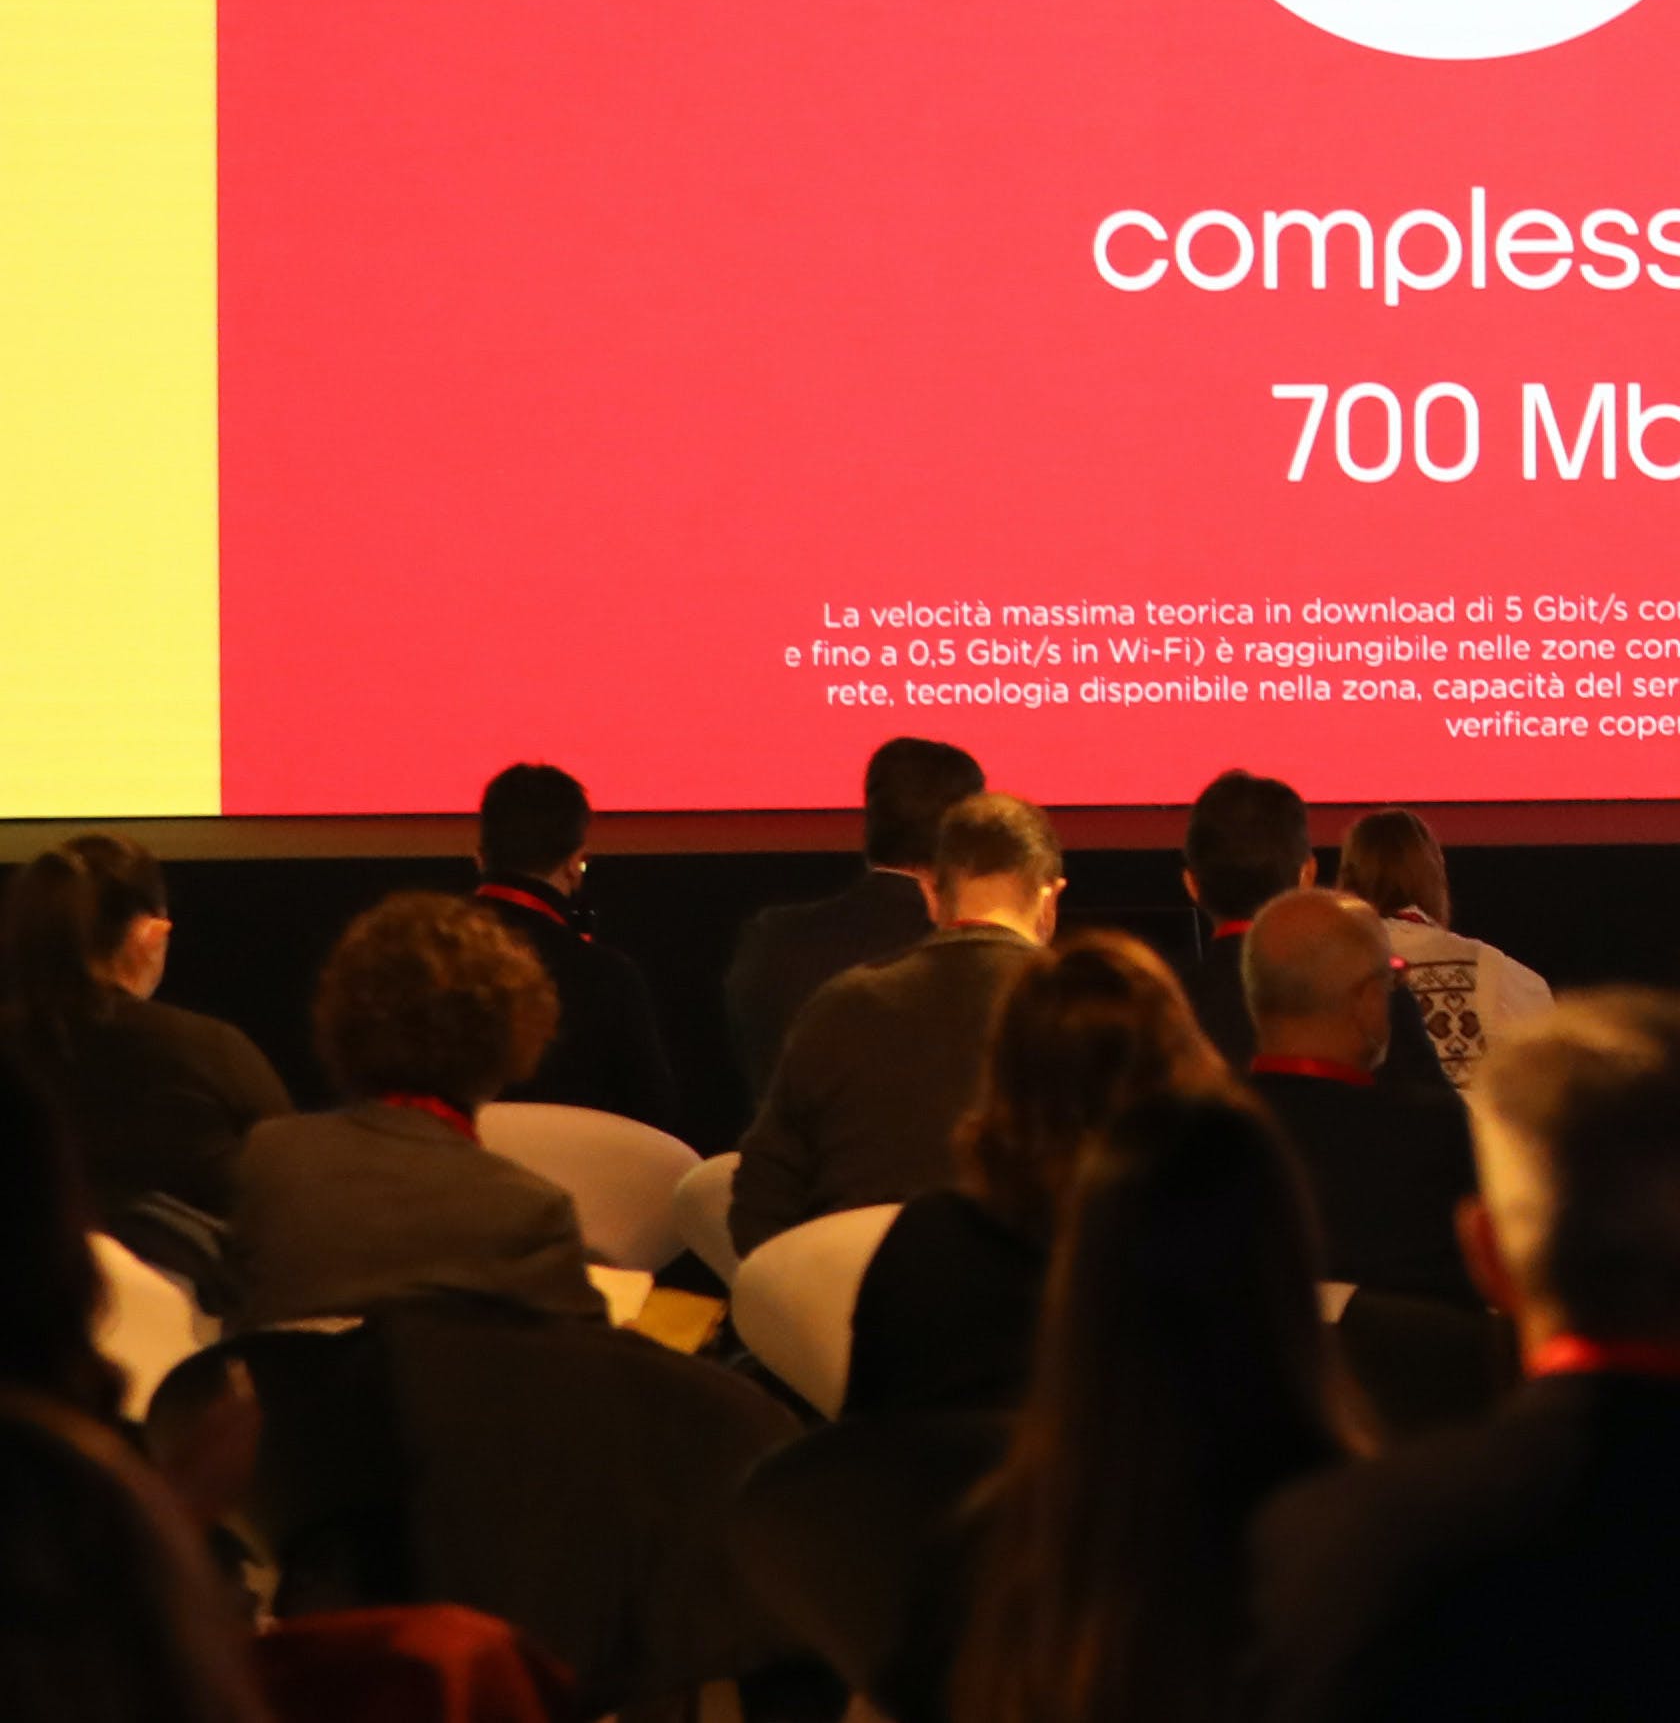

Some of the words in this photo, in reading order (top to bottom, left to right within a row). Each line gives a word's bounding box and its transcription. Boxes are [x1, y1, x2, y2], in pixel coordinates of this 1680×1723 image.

[1271, 381, 1480, 483] 700
[823, 602, 860, 629] La
[869, 600, 992, 628] velocità
[1002, 599, 1135, 627] massima
[1145, 597, 1254, 626] teorica
[1265, 597, 1292, 624] in
[1301, 596, 1455, 625] download
[1465, 595, 1494, 623] di
[1505, 595, 1523, 623] 5
[1533, 592, 1629, 625] Gbit/s
[784, 645, 802, 668] e
[811, 639, 871, 667] fino
[879, 645, 898, 667] a
[907, 638, 956, 668] 0,5
[966, 635, 1062, 668] Gbit/s
[1072, 637, 1099, 664] in
[1107, 636, 1206, 667] Wi-Fi)
[1215, 636, 1234, 664] è
[1244, 634, 1449, 668] raggiungibile
[1458, 634, 1531, 661] nelle
[1541, 638, 1616, 661] zone
[827, 680, 895, 707] rete,
[905, 676, 1069, 709] tecnologia
[1079, 674, 1249, 707] disponibile
[1259, 674, 1332, 702] nella
[1341, 678, 1423, 702] zona,
[1432, 671, 1565, 704] capacità
[1575, 671, 1622, 699] del
[1445, 709, 1589, 738] verificare
